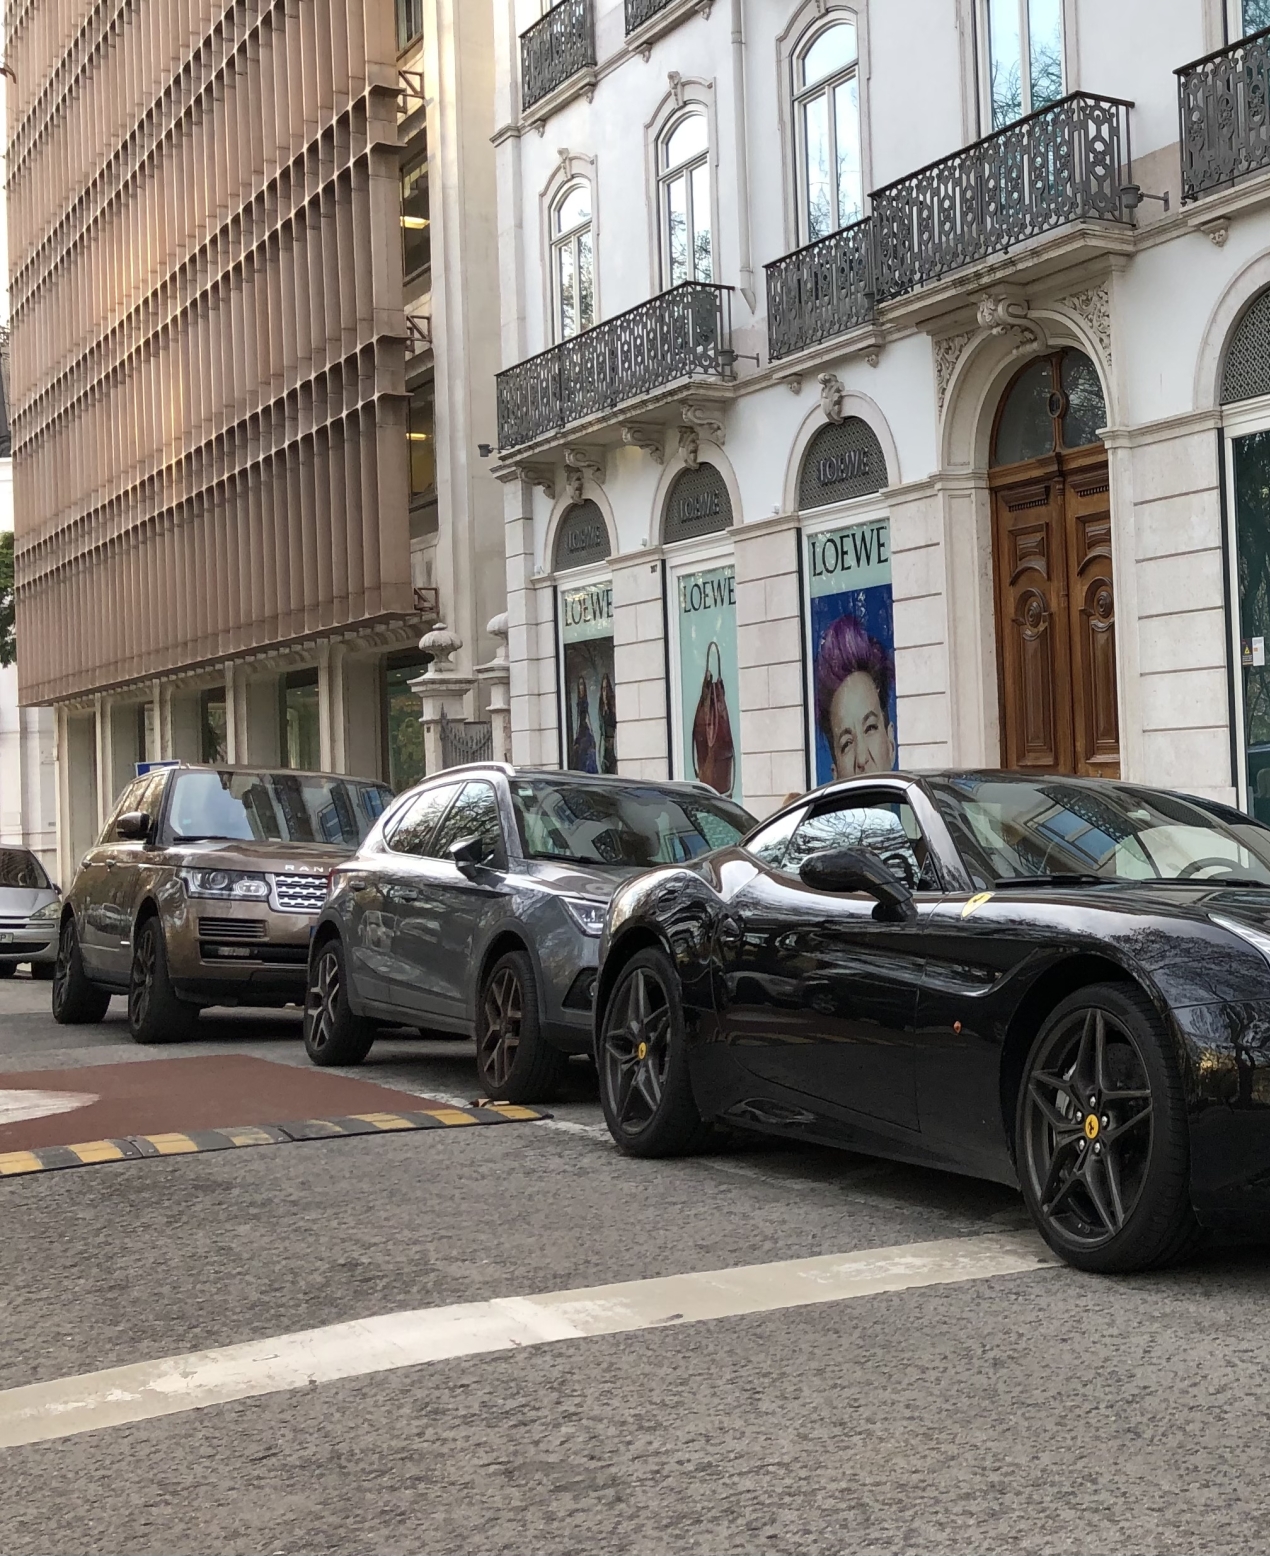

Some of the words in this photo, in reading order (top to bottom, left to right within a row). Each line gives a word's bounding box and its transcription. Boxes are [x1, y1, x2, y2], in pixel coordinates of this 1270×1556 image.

[819, 449, 869, 485] LOEWE
[811, 525, 889, 577] LOEWE
[564, 588, 613, 626] LOEWE
[683, 576, 736, 613] LOEWE
[285, 864, 332, 872] RAN
